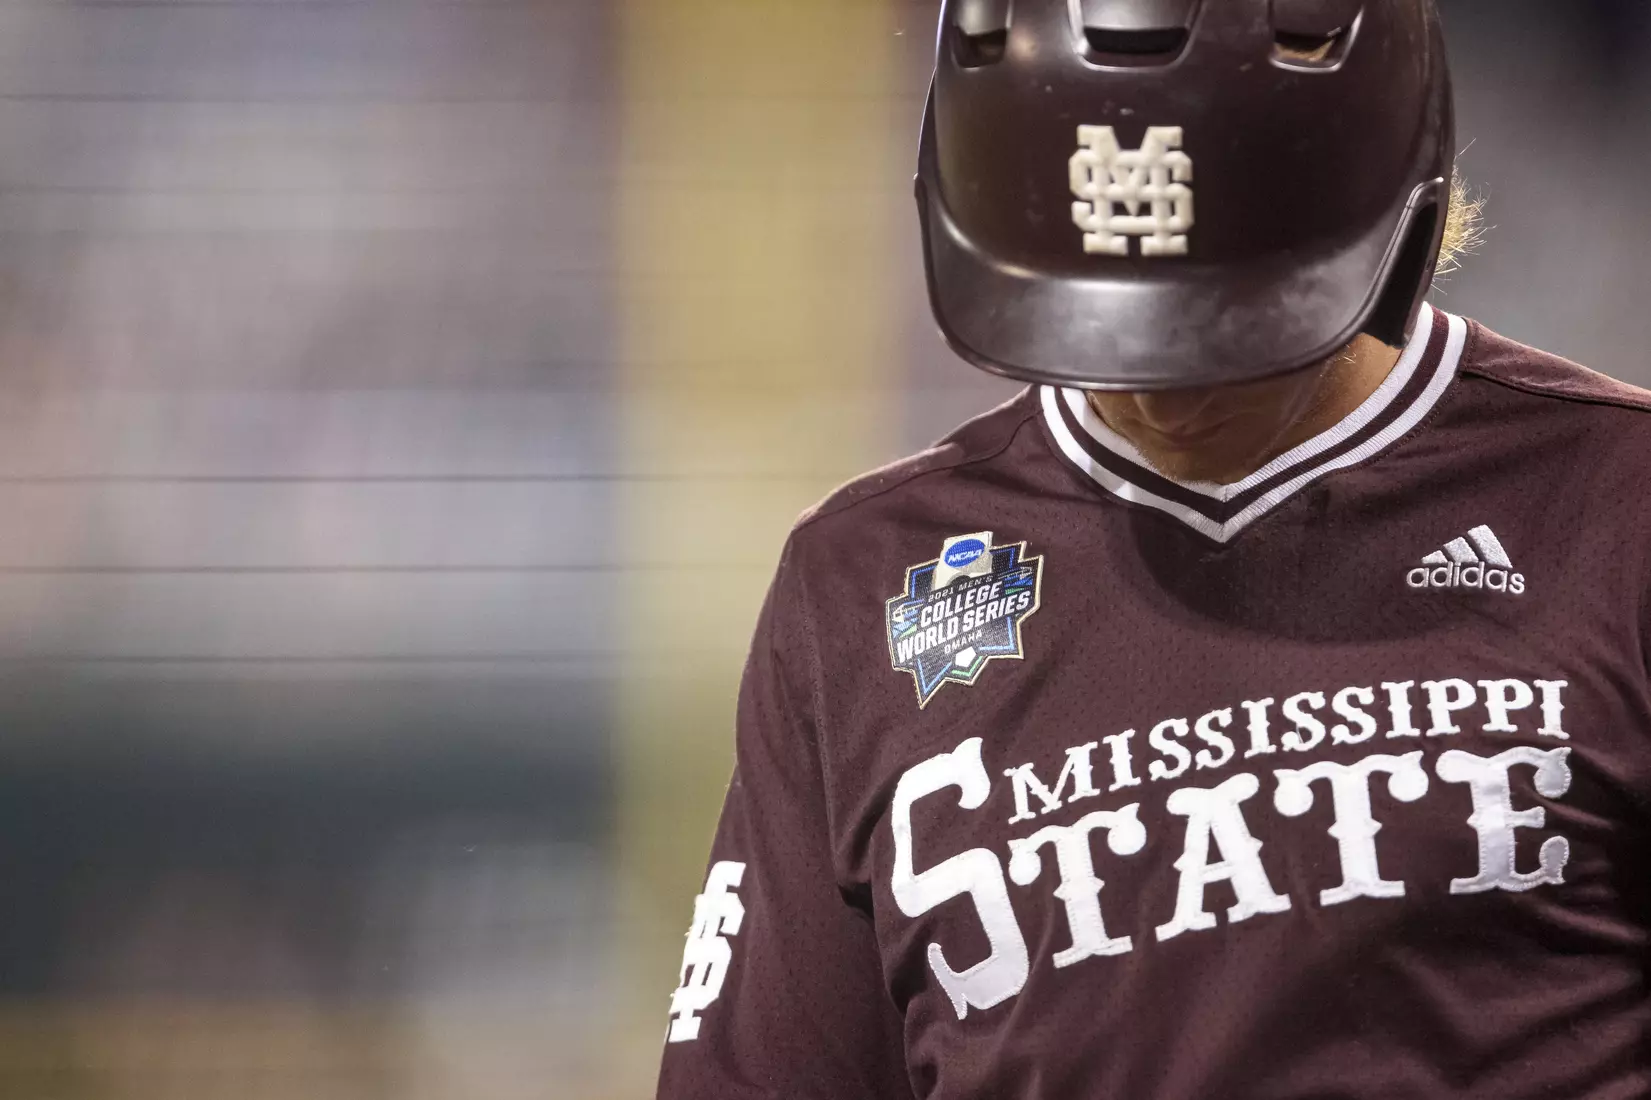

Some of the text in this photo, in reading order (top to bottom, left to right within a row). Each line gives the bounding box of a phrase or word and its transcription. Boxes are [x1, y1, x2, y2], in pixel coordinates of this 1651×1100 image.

[947, 549, 982, 563] NCAA
[928, 575, 993, 602] 2021 MEN'S
[1406, 561, 1525, 594] adidas
[920, 581, 1003, 628] COLLEGE
[896, 590, 1031, 664] WORLD SERIES
[944, 629, 983, 655] OMAHA
[1003, 678, 1570, 826] MISSISSIPPI
[891, 737, 1571, 1019] STATE
